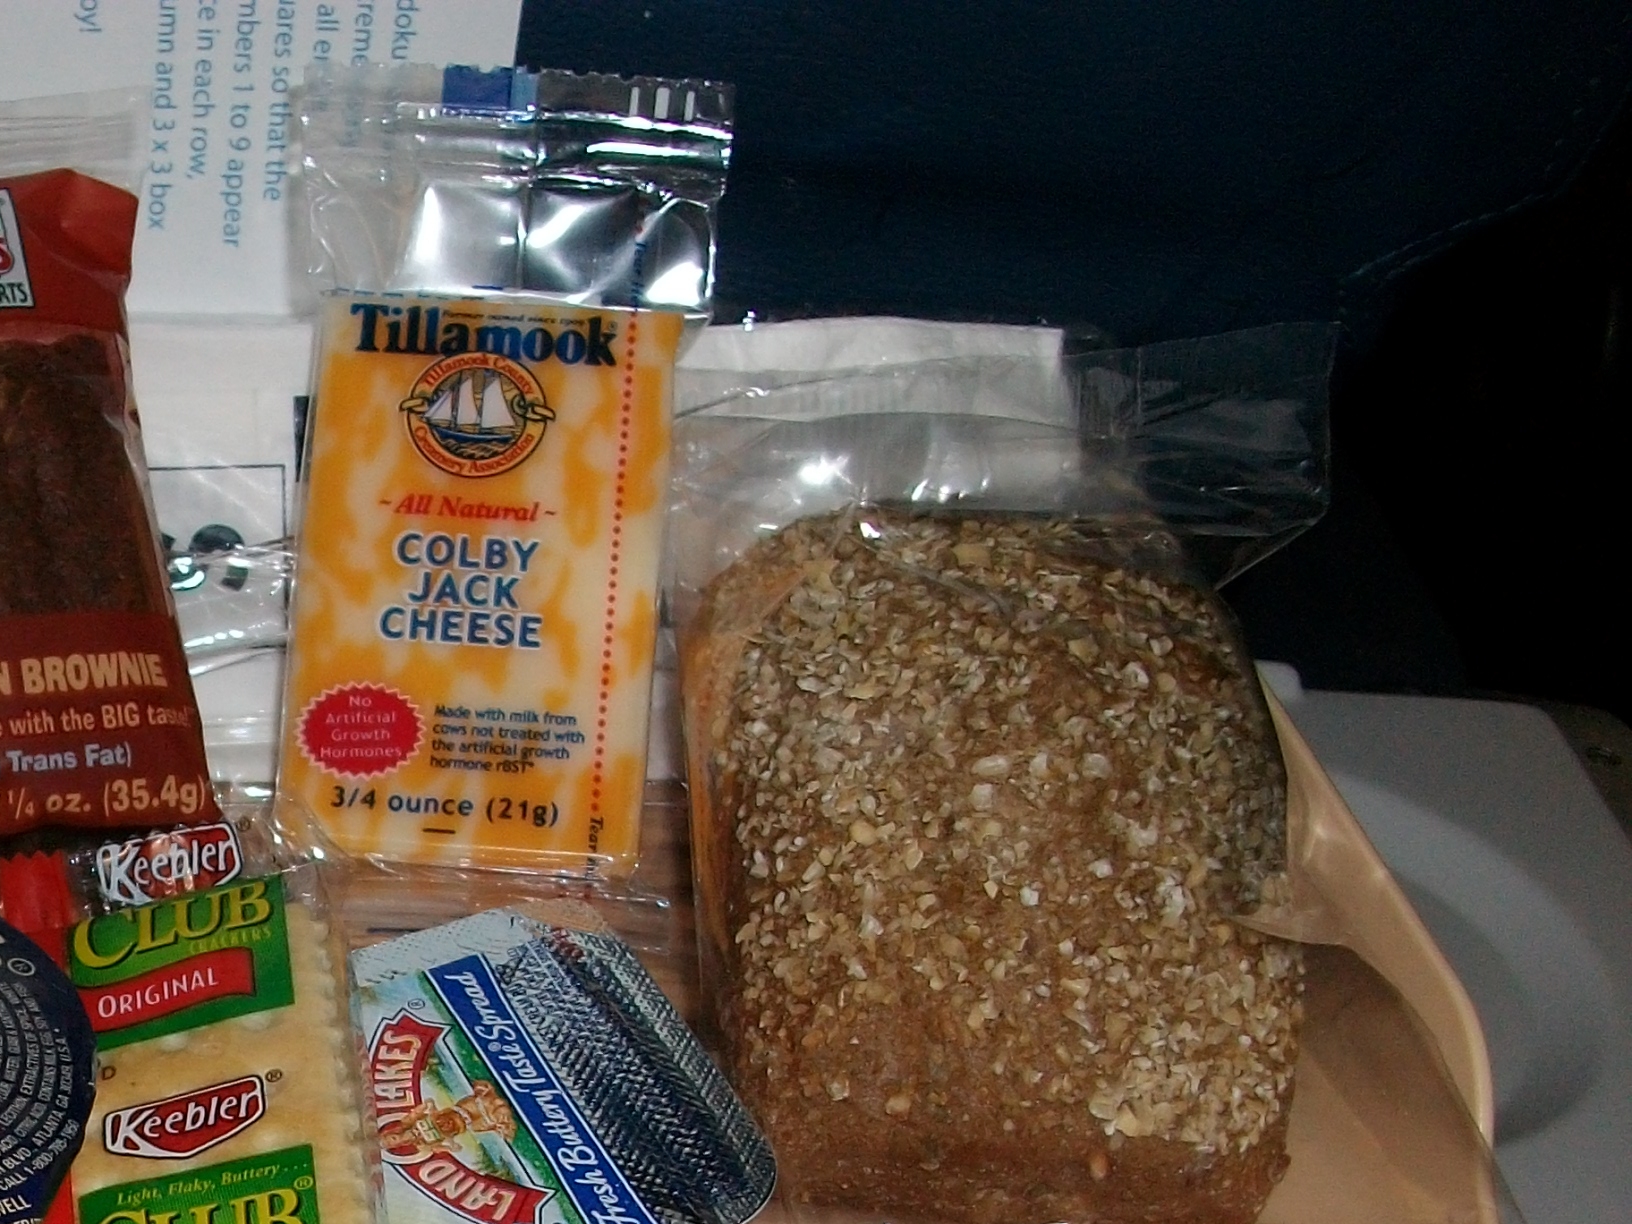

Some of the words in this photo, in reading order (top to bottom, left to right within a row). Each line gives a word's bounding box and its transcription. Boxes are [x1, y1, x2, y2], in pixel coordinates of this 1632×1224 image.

[315, 3, 340, 32] all
[196, 28, 220, 51] in
[155, 62, 178, 110] and
[192, 59, 216, 118] each
[232, 84, 255, 92] 1
[271, 65, 291, 94] so
[153, 118, 175, 132] 3
[230, 103, 252, 129] to
[265, 101, 293, 151] that
[152, 139, 169, 152] x
[185, 127, 209, 180] row,
[227, 137, 252, 151] 9
[150, 161, 173, 175] 3
[262, 160, 290, 202] the
[147, 184, 173, 230] box
[218, 158, 245, 248] appear
[350, 302, 617, 366] Tillamook
[394, 492, 432, 518] All
[438, 498, 541, 525] Natural
[396, 532, 541, 574] COLBY
[406, 569, 522, 610] JACK
[378, 606, 544, 649] CHEESE
[20, 651, 168, 695] BROWNIE
[9, 708, 55, 736] with
[60, 707, 96, 733] the
[101, 701, 141, 729] BIG
[325, 710, 397, 725] Artificial
[349, 695, 373, 708] No
[433, 704, 471, 719] Made
[475, 707, 506, 723] with
[509, 709, 540, 724] milk
[543, 711, 578, 726] from
[319, 743, 403, 761] Hormones
[330, 727, 391, 743] Growth
[432, 723, 468, 736] cows
[471, 725, 494, 738] not
[499, 726, 551, 742] treated
[554, 730, 586, 744] with
[432, 738, 456, 752] the
[459, 740, 518, 756] artificial
[520, 745, 571, 760] growth
[6, 749, 78, 774] Trans
[84, 740, 133, 768] Fat)
[430, 754, 493, 772] hormone
[45, 792, 92, 813] oz.
[104, 774, 206, 819] (35.4g)
[330, 785, 377, 808] 3/4
[387, 793, 475, 817] ounce
[485, 798, 560, 827] (21g)
[588, 816, 604, 853] Tear
[101, 838, 235, 905] Keebler
[74, 882, 272, 969] CLUB
[188, 926, 273, 954] CRACKERS
[97, 966, 219, 1019] ORIGINAL
[444, 971, 517, 1044] Spread
[375, 1029, 423, 1109] LAKES
[498, 1043, 545, 1093] Taste
[110, 1087, 263, 1155] Keebler
[531, 1089, 600, 1172] Buttery
[118, 1186, 163, 1207] Light,
[168, 1177, 216, 1196] Flaky,
[419, 1159, 517, 1222] LAND
